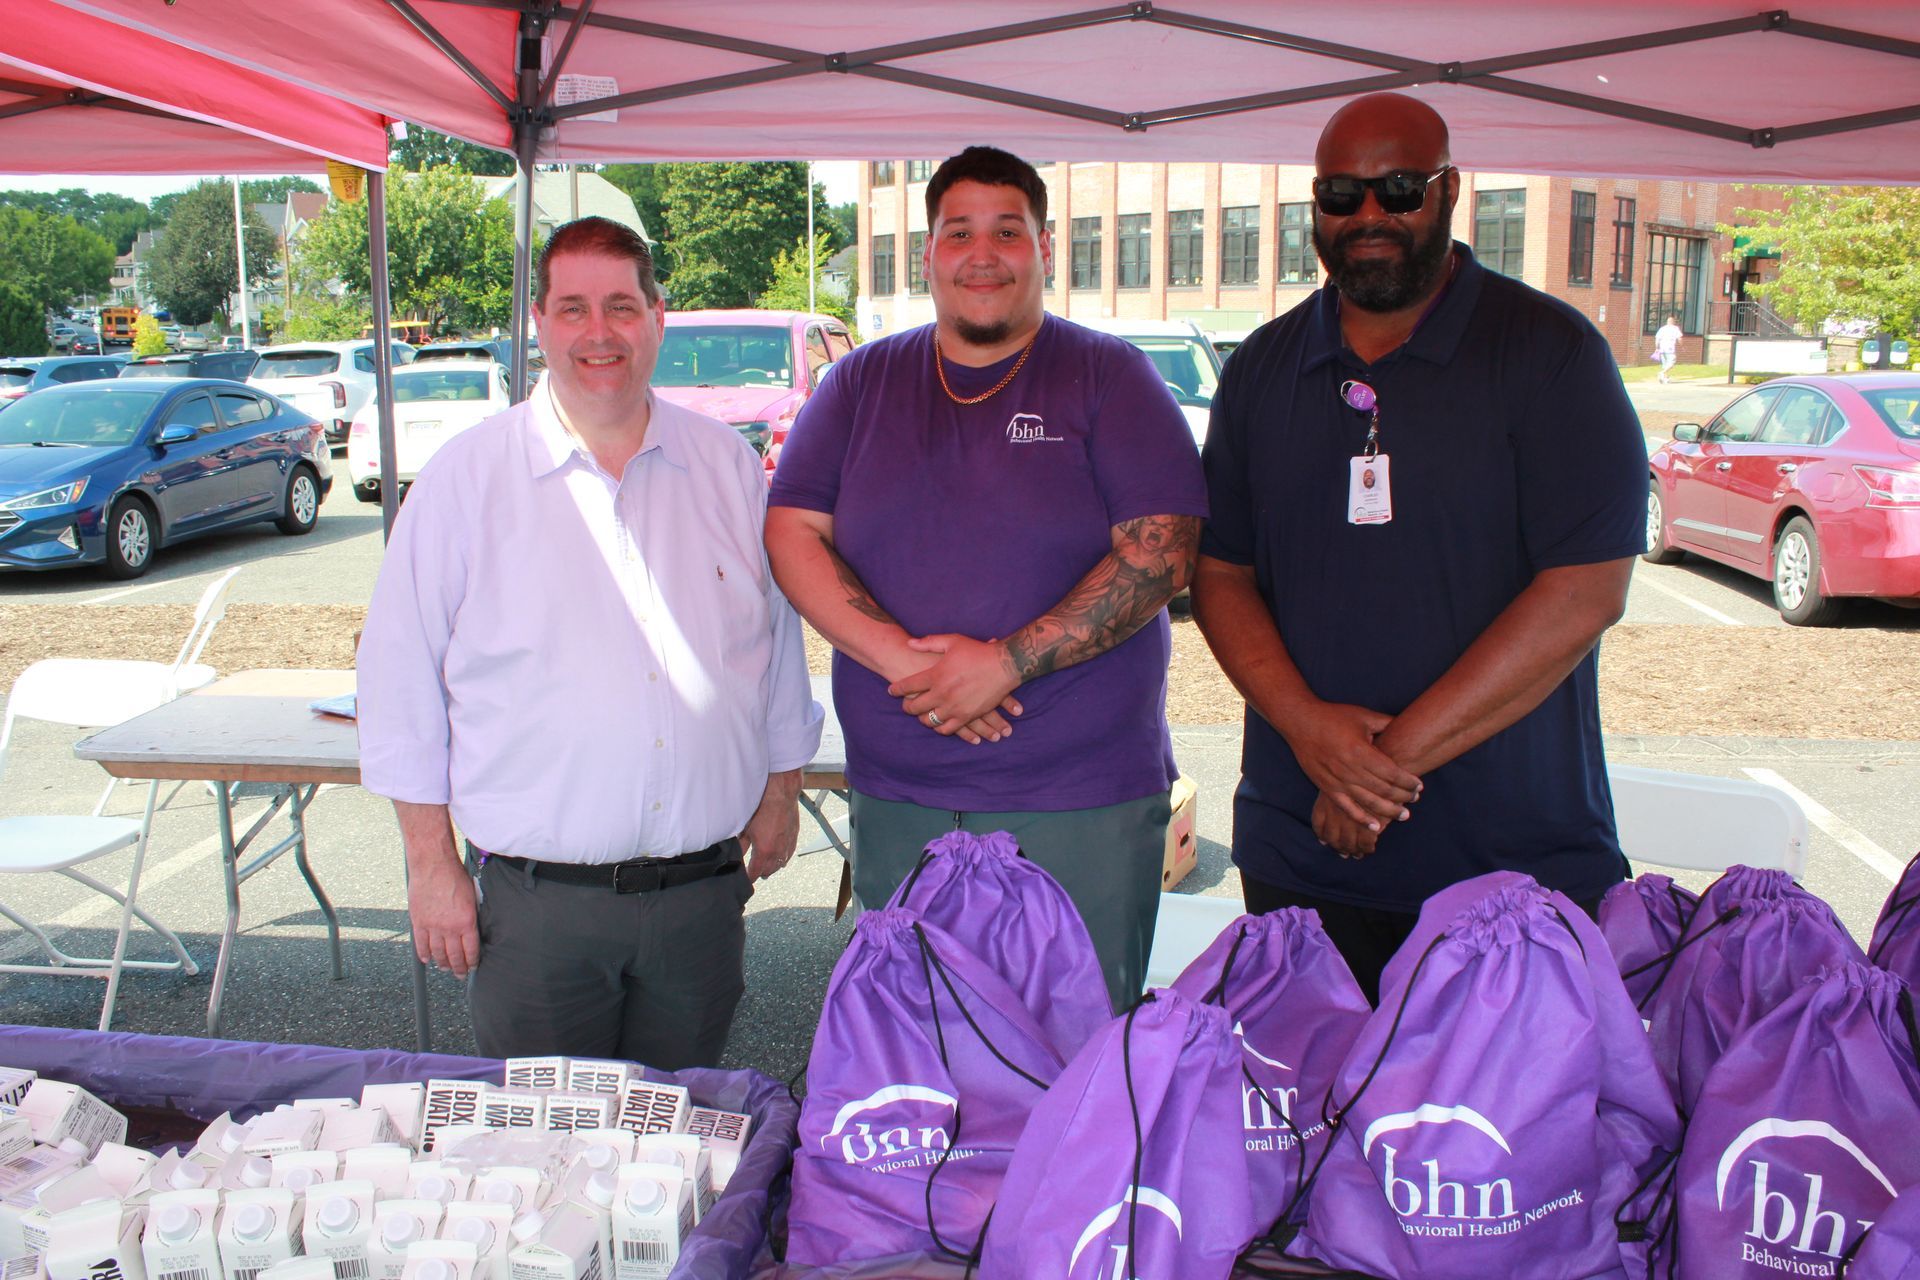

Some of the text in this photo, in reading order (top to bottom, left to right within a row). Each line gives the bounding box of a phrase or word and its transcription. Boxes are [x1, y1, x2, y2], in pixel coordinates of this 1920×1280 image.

[1011, 422, 1044, 438] bhn
[644, 1092, 679, 1134] BOXE
[714, 1114, 744, 1140] BOXED
[1382, 1143, 1519, 1219] bhn
[1469, 1218, 1521, 1236] Health
[1524, 1189, 1584, 1225] Network
[1744, 1160, 1875, 1262] bh
[1741, 1242, 1836, 1277] Behavioral
